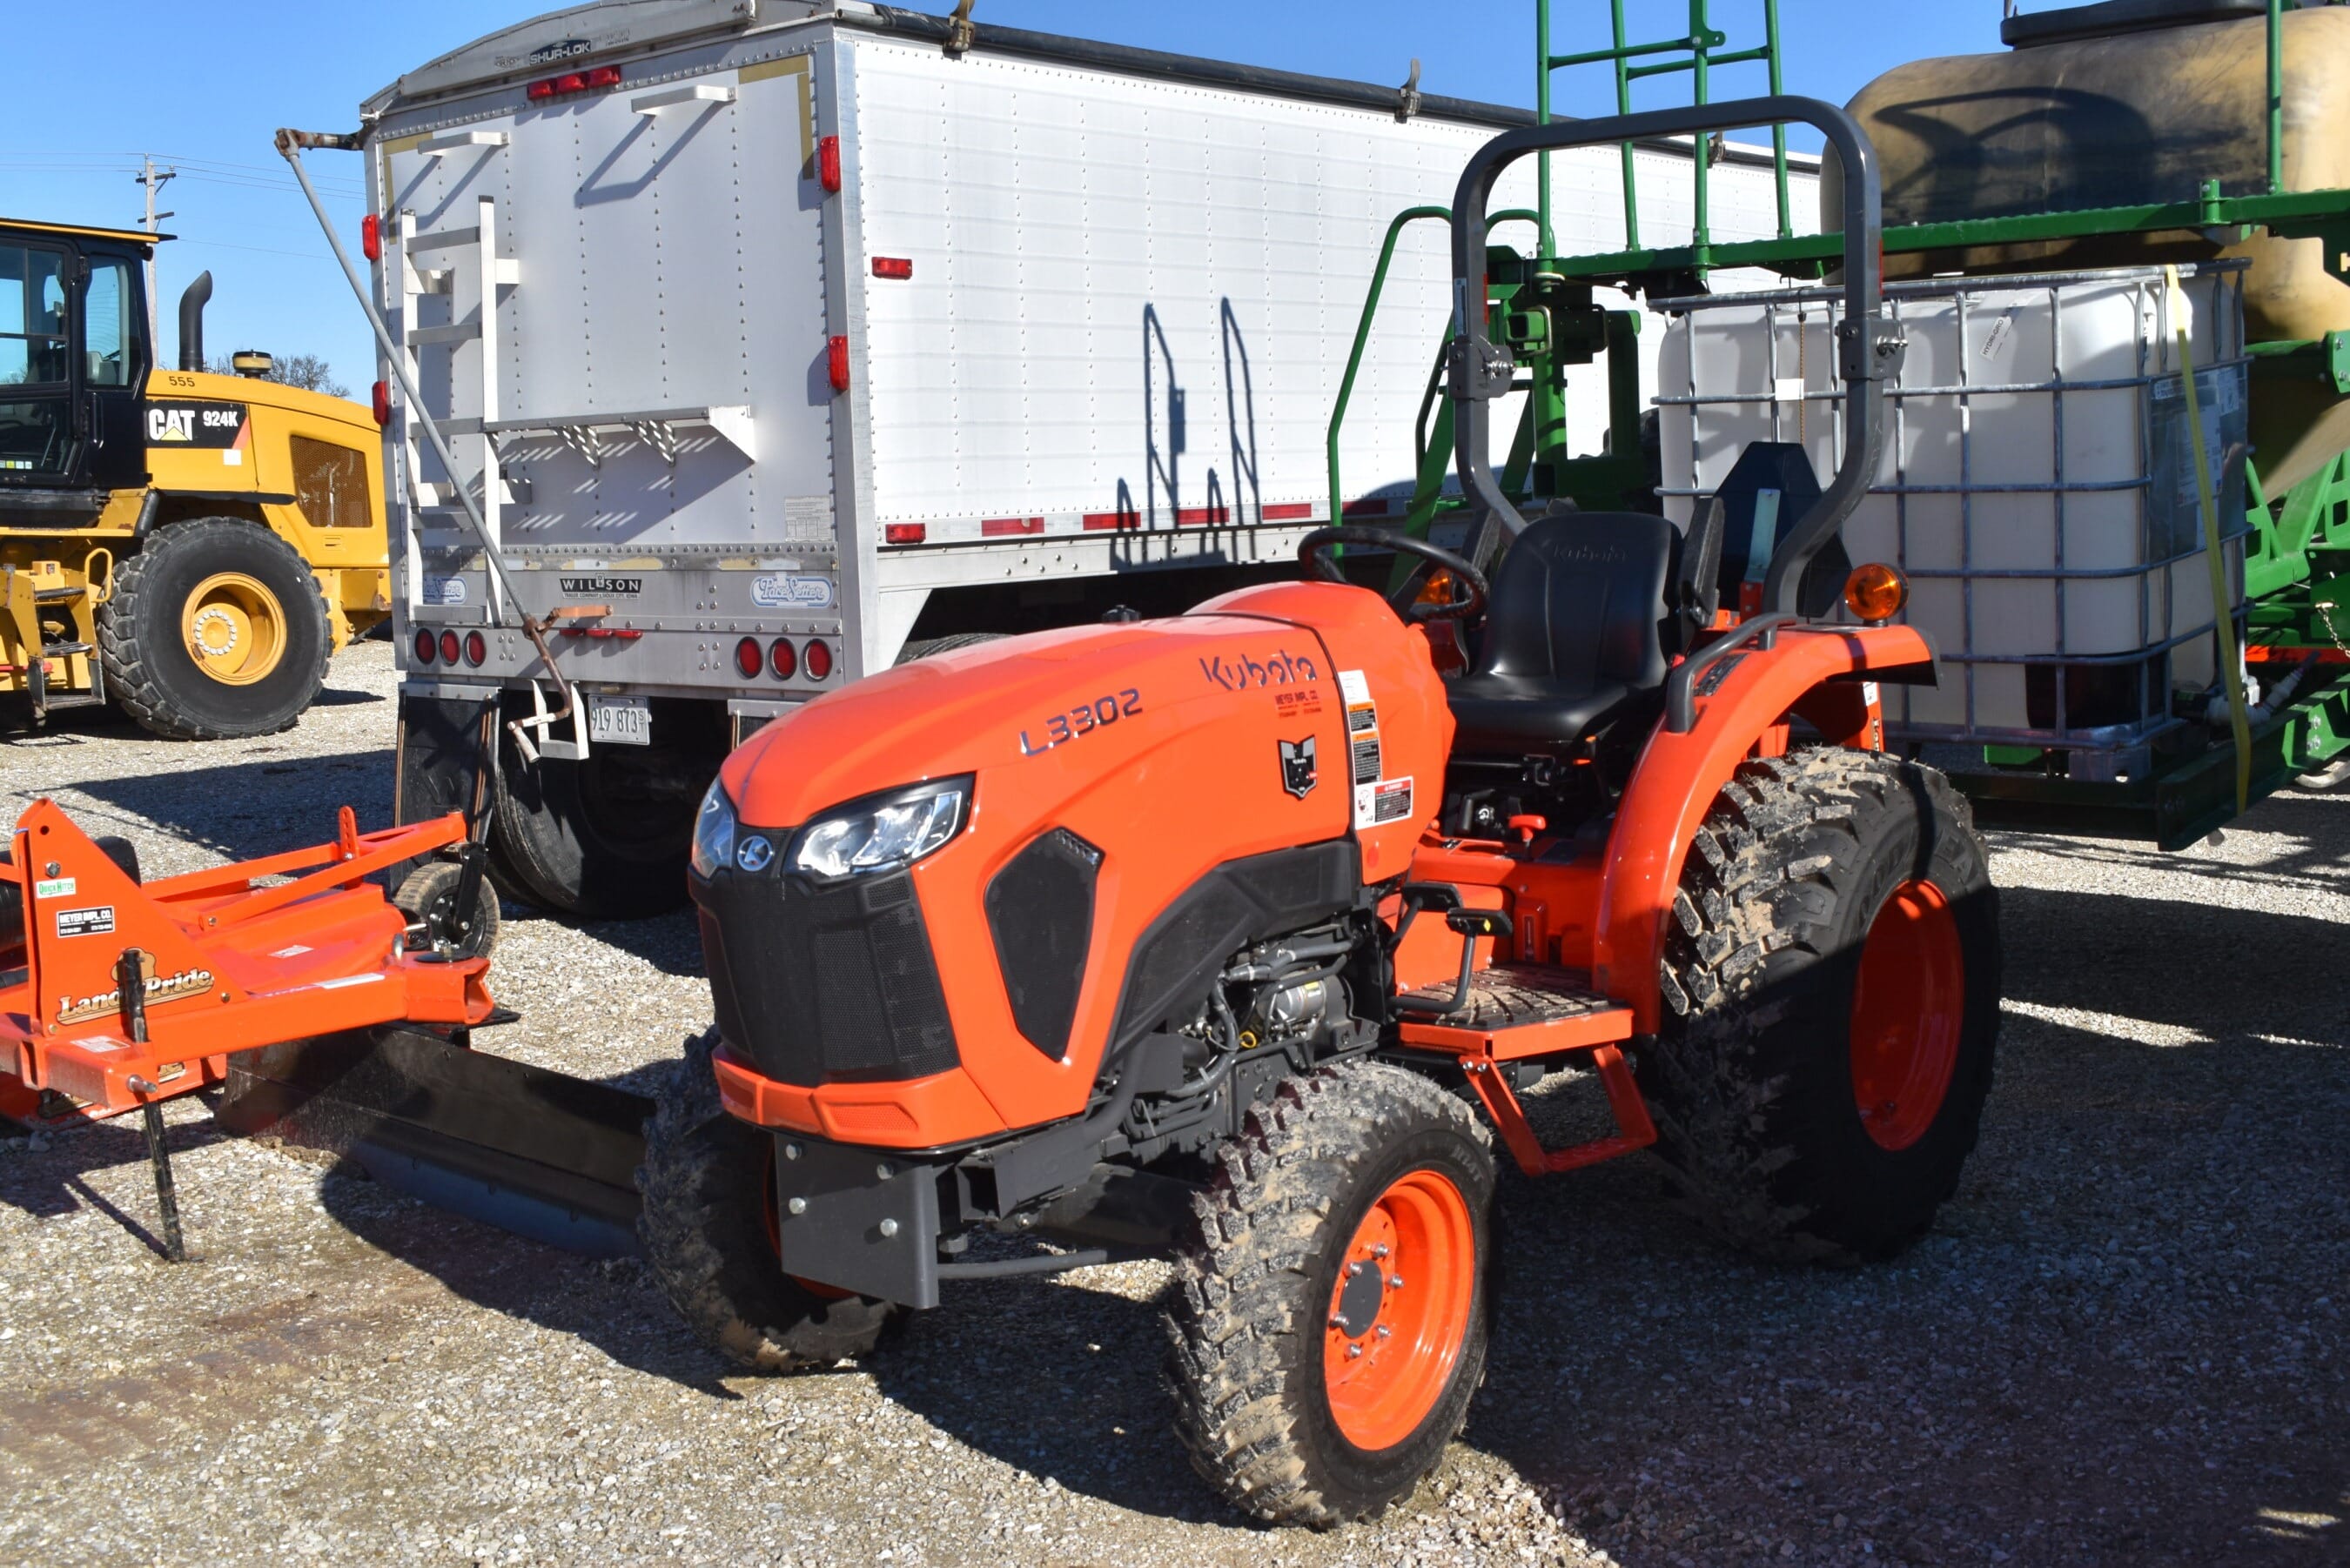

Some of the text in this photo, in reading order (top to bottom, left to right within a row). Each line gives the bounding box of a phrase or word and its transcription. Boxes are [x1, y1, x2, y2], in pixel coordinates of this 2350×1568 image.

[530, 43, 591, 65] SHUR-LOK
[168, 376, 196, 388] 555
[148, 408, 239, 441] CAT 924K
[561, 580, 639, 591] WILSON
[1200, 649, 1317, 691] Kubota
[592, 707, 611, 732] 919
[616, 707, 638, 734] 873
[1020, 688, 1144, 756] L3302
[143, 968, 212, 998] Pride
